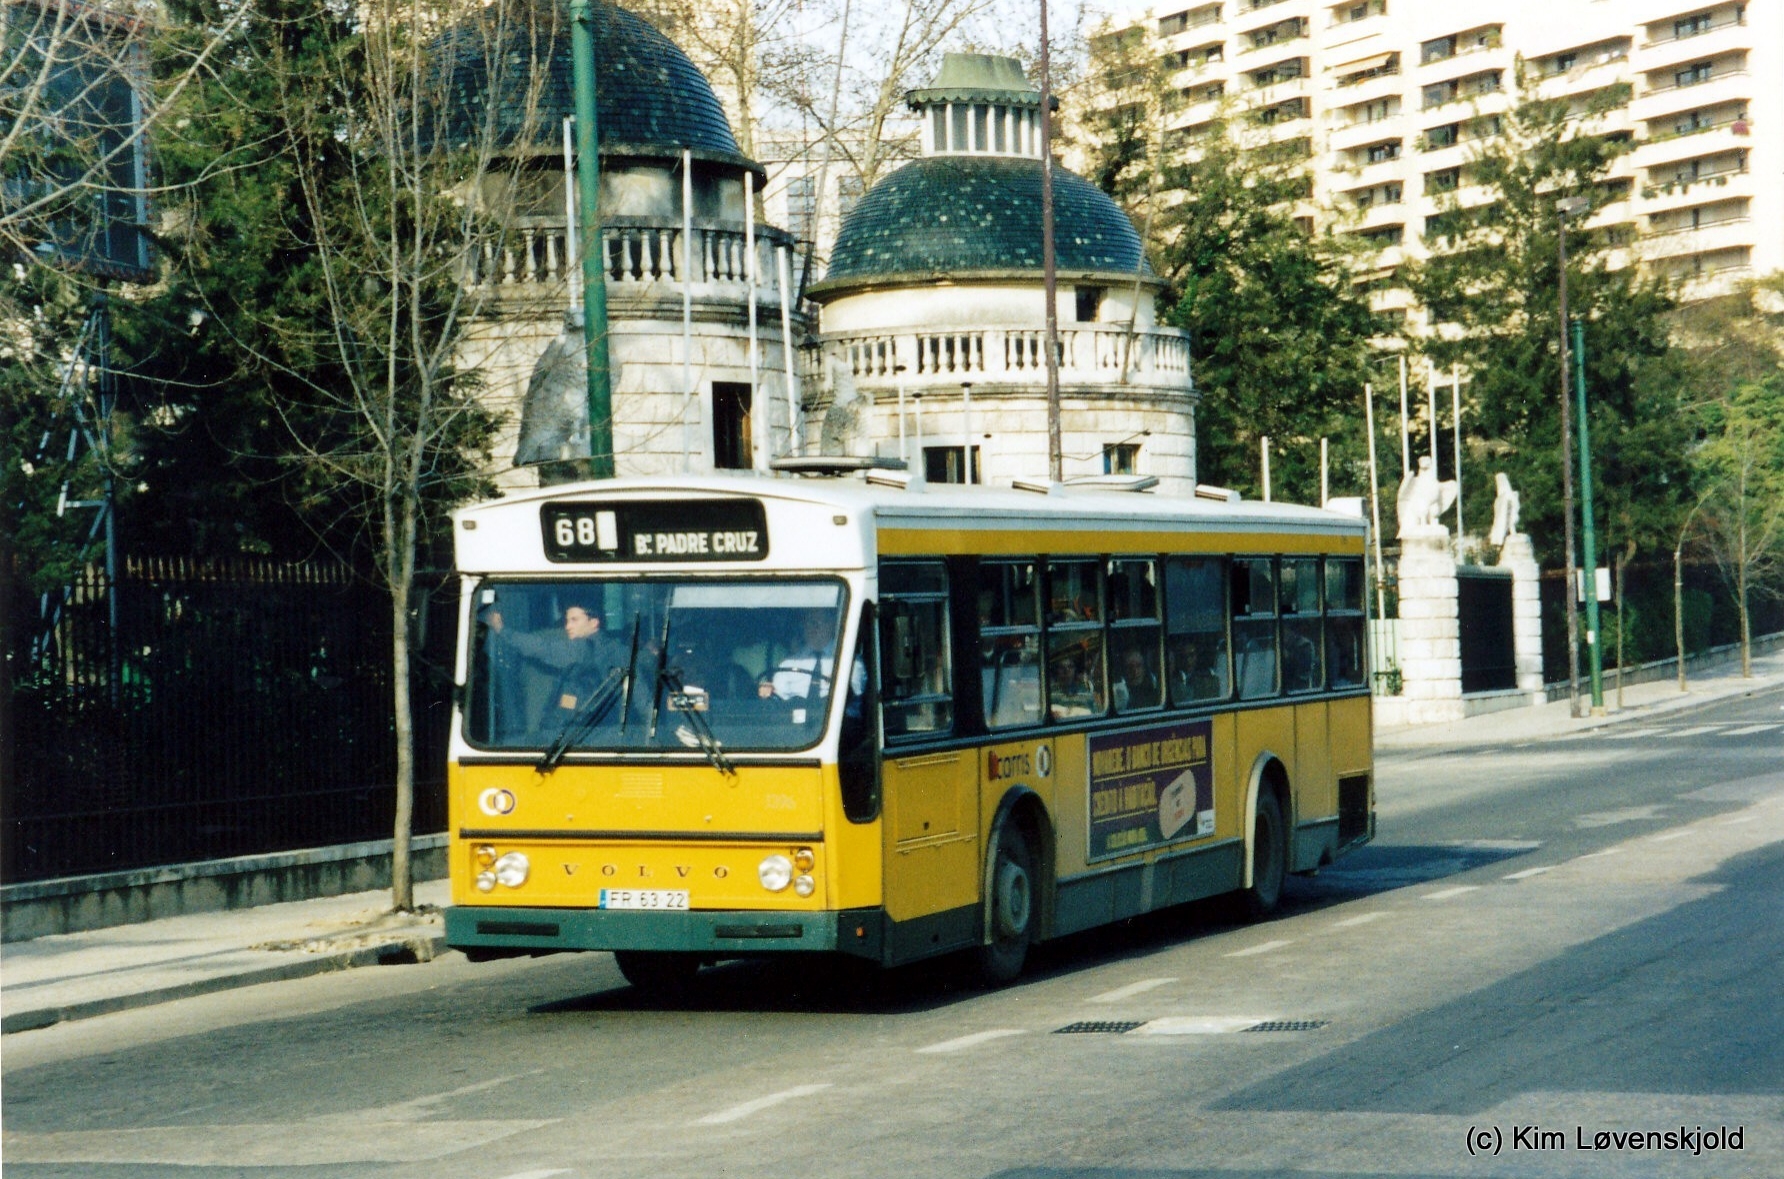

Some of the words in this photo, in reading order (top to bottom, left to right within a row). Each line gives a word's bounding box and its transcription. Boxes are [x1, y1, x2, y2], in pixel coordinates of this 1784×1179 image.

[555, 517, 596, 546] 68
[656, 531, 708, 554] PADRE
[713, 530, 759, 552] CRUZ
[563, 863, 728, 879] VOLVO
[610, 891, 633, 907] FR
[640, 892, 658, 907] 63
[666, 892, 685, 908] 22
